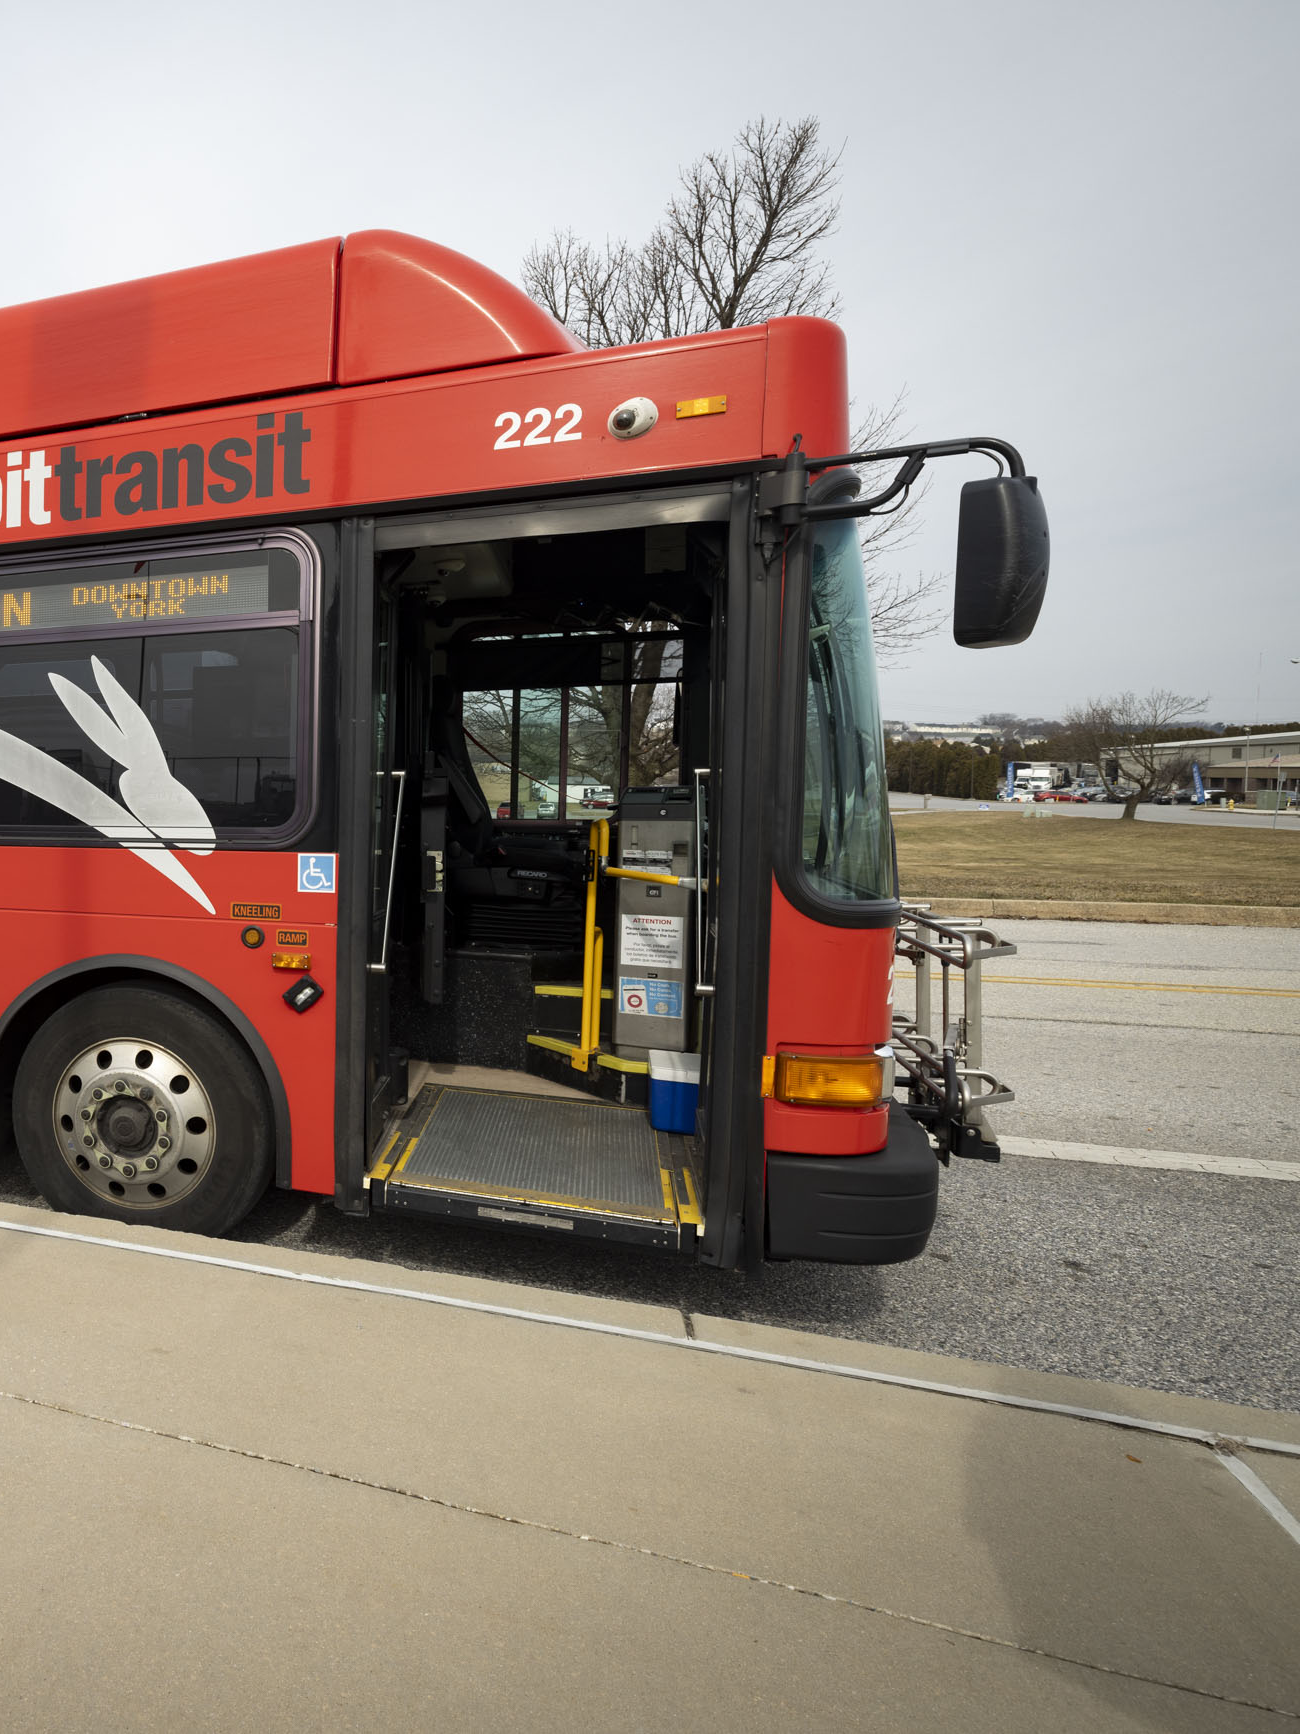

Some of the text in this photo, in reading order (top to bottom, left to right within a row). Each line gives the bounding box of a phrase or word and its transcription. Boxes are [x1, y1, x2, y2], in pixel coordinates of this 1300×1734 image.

[493, 403, 583, 451] 222
[72, 574, 229, 607] DOWNTOWN
[111, 598, 186, 619] YORK
[516, 870, 548, 879] RECARO
[234, 905, 279, 919] KNEELING
[632, 917, 672, 926] ATTENTION
[278, 932, 306, 945] RAMP
